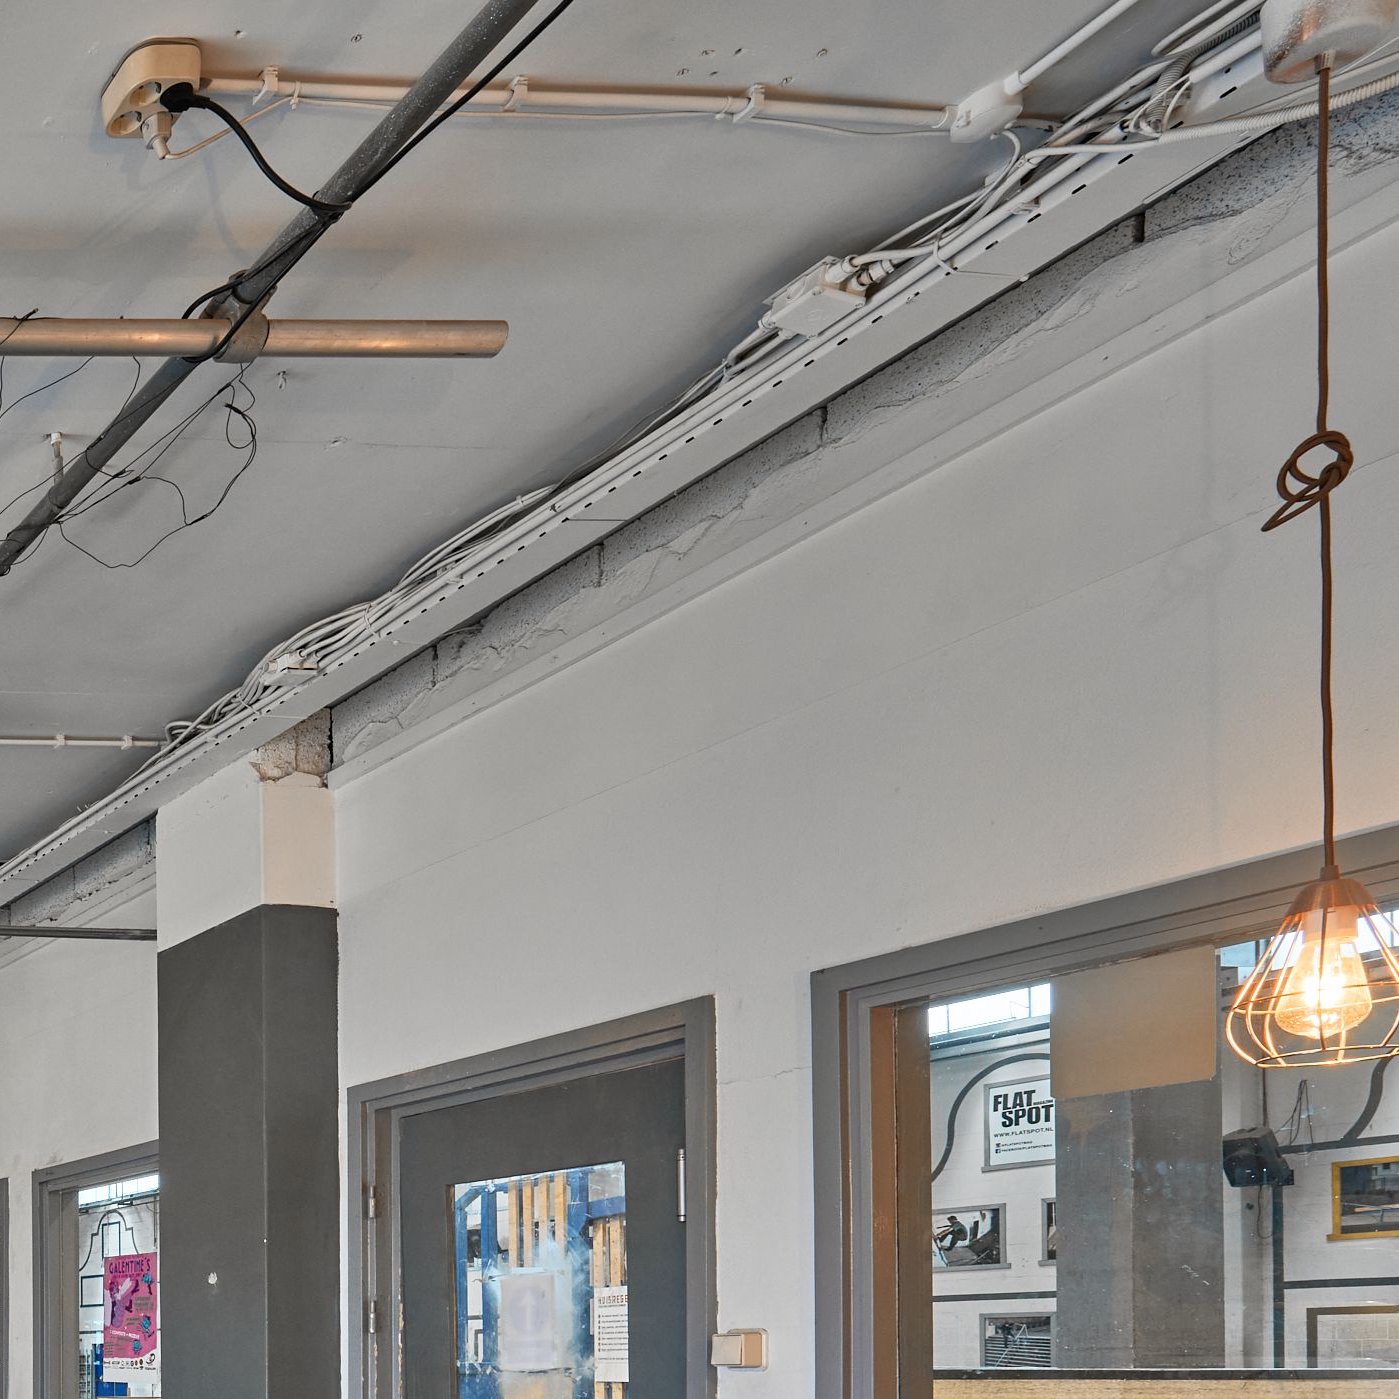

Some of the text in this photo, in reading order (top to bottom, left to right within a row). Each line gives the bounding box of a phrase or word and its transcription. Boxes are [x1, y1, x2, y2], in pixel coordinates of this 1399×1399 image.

[993, 1089, 1036, 1112] FLAT
[1002, 1104, 1054, 1128] SPOT
[993, 1127, 1054, 1138] WWW.FLATSPOT.NL
